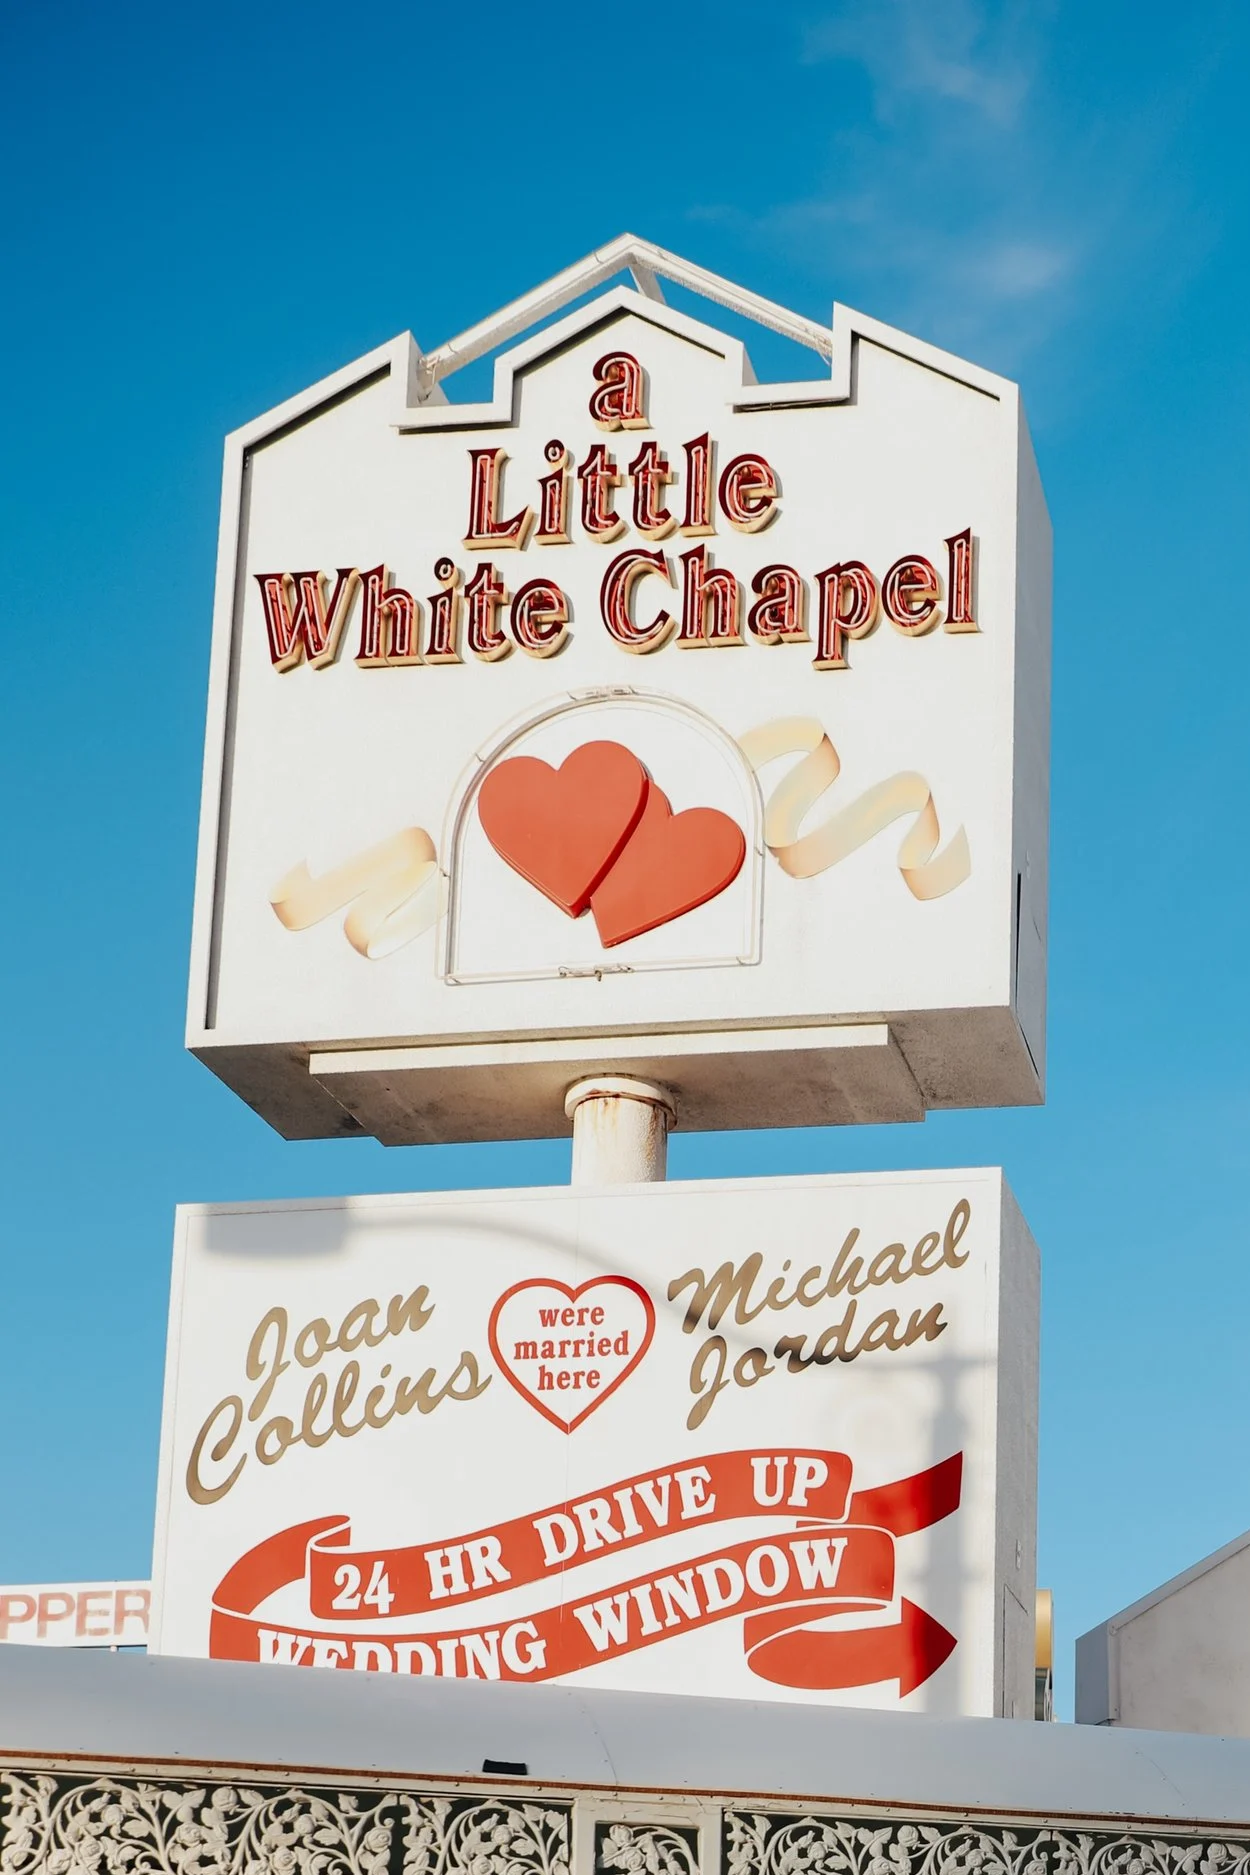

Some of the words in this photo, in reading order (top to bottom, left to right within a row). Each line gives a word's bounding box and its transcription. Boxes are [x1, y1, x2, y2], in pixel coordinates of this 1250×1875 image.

[588, 350, 652, 431] a
[461, 431, 782, 550] Little
[254, 557, 573, 673] White
[600, 527, 981, 670] Chapel
[538, 1304, 605, 1328] were
[667, 1198, 972, 1333] Michael
[246, 1284, 436, 1420] Joan
[513, 1331, 630, 1361] married
[537, 1364, 601, 1391] here
[686, 1301, 949, 1431] Jordan
[185, 1351, 493, 1505] Collins
[332, 1560, 396, 1613] 24
[424, 1535, 512, 1600] HR
[535, 1466, 718, 1569] DRIVE
[751, 1456, 830, 1507] UP
[257, 1620, 548, 1681] WEDDING
[573, 1538, 851, 1653] WINDOW
